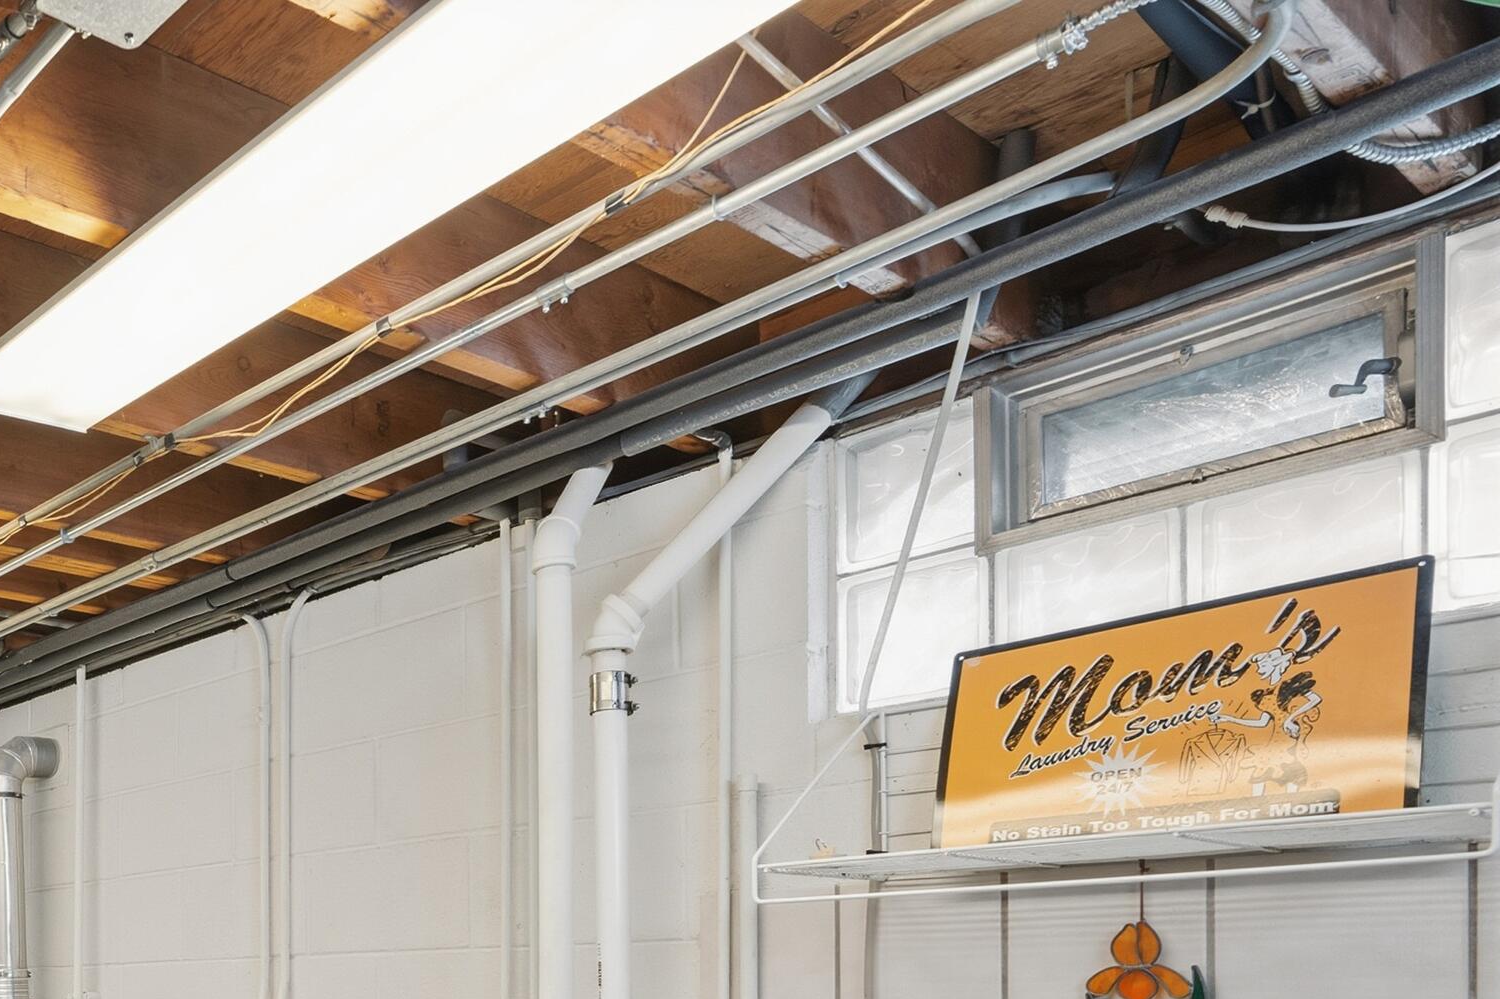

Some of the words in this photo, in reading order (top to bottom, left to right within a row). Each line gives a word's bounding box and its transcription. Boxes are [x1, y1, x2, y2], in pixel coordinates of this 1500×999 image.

[996, 597, 1342, 752] Mom's
[1008, 732, 1115, 779] Laundry
[1123, 700, 1223, 743] Service
[1090, 766, 1143, 783] OPEN
[1097, 780, 1134, 795] 24/7
[992, 828, 1020, 843] No
[1027, 822, 1082, 840] Stain
[1088, 818, 1129, 833] Too
[1138, 811, 1211, 830] Tough
[1219, 806, 1262, 822] For
[1268, 799, 1336, 818] Mom
